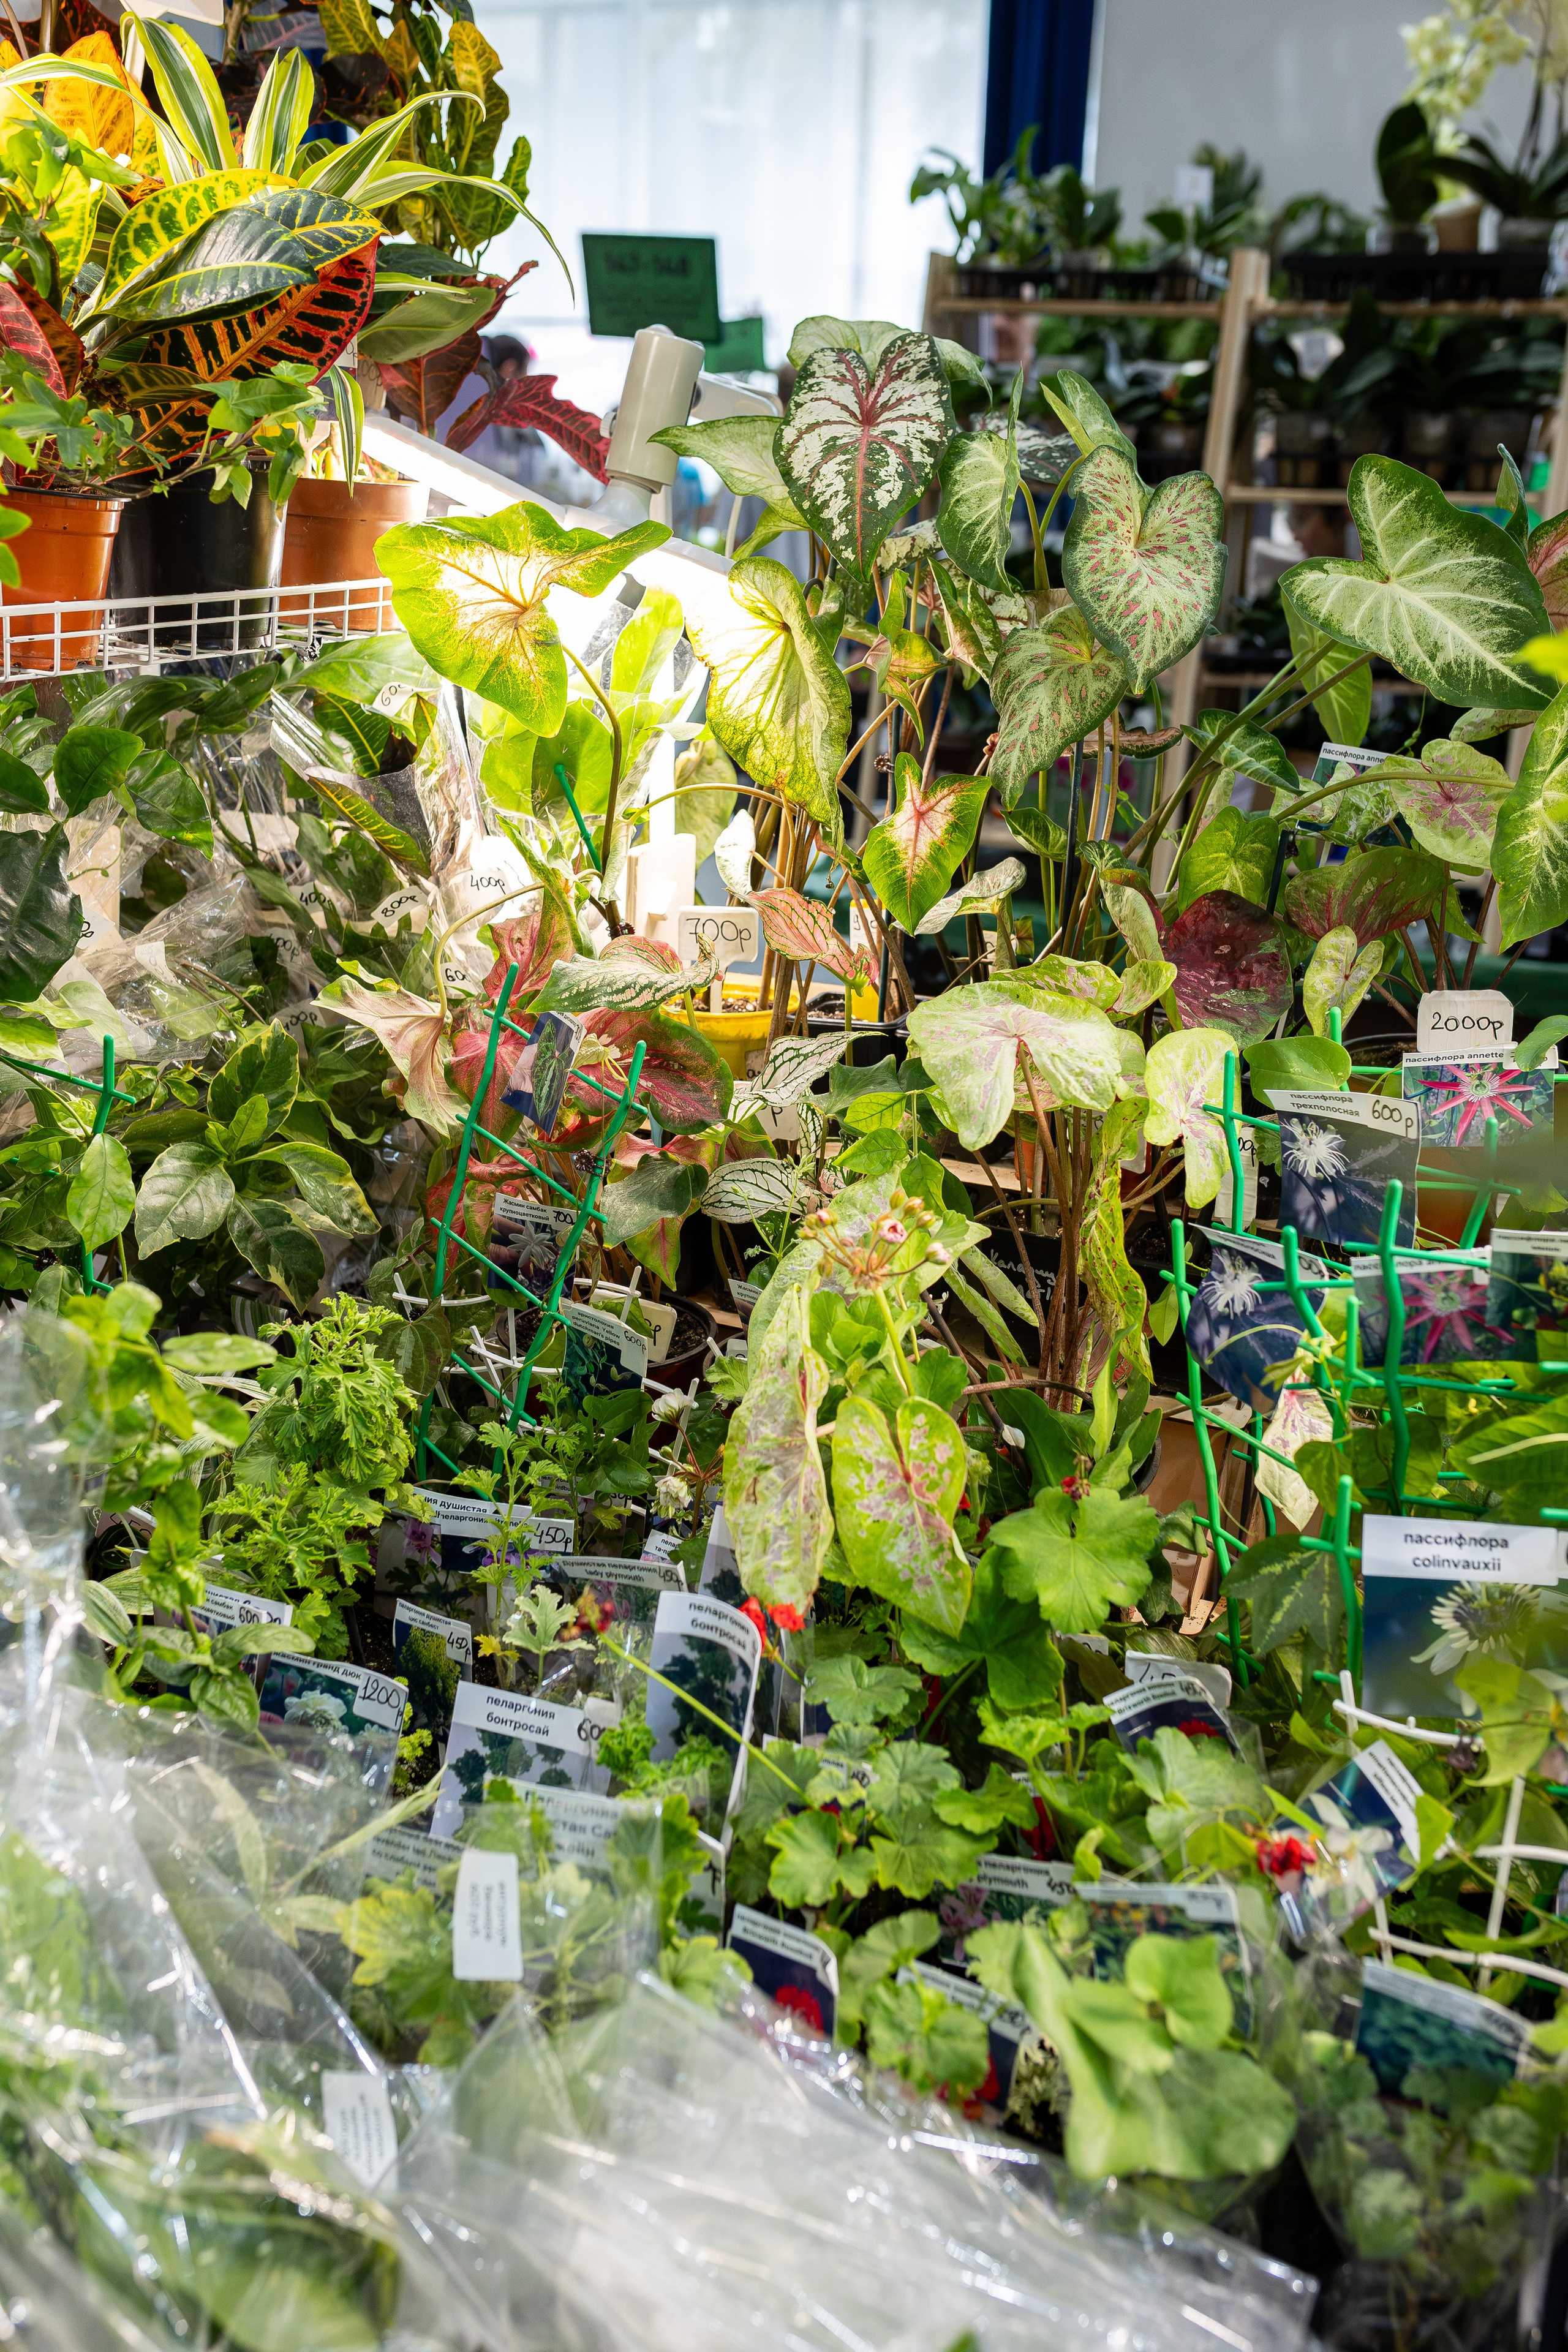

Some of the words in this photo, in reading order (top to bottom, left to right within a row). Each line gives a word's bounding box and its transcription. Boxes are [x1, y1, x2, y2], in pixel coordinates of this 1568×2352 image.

[1322, 747, 1365, 761] пассифлора
[1366, 755, 1385, 764] anne
[470, 875, 506, 895] 400р
[381, 894, 419, 918] 800р
[686, 918, 752, 952] 700р
[270, 933, 300, 963] 00р
[1430, 1012, 1504, 1041] 2000р
[1405, 1054, 1464, 1063] пассифлора
[1290, 1093, 1353, 1104] пассифлора
[1290, 1102, 1360, 1117] трехполосная
[1237, 1137, 1257, 1167] 00р
[499, 1207, 549, 1221] крупноцветковый
[503, 1197, 526, 1209] Жасмин
[526, 1204, 548, 1213] самбак
[552, 1210, 575, 1226] 700
[737, 1284, 760, 1295] Жасмин
[577, 1311, 614, 1330] аристолохия
[573, 1321, 605, 1339] dutchman's
[605, 1336, 620, 1346] pipes
[601, 1327, 620, 1340] Yellow
[624, 1330, 647, 1355] 600р
[439, 1500, 488, 1513] душистая
[534, 1522, 573, 1552] 450р
[1403, 1532, 1510, 1551] пассифлора
[607, 1562, 658, 1574] пеларгония
[1412, 1555, 1501, 1572] colinvauxii
[605, 1571, 644, 1582] plymouth
[398, 1602, 426, 1617] пеларгония
[447, 1630, 471, 1662] 450р
[341, 1668, 362, 1680] дюк
[358, 1676, 404, 1727] 1200р
[486, 1695, 556, 1720] пеларгония
[486, 1712, 549, 1737] бонтросай
